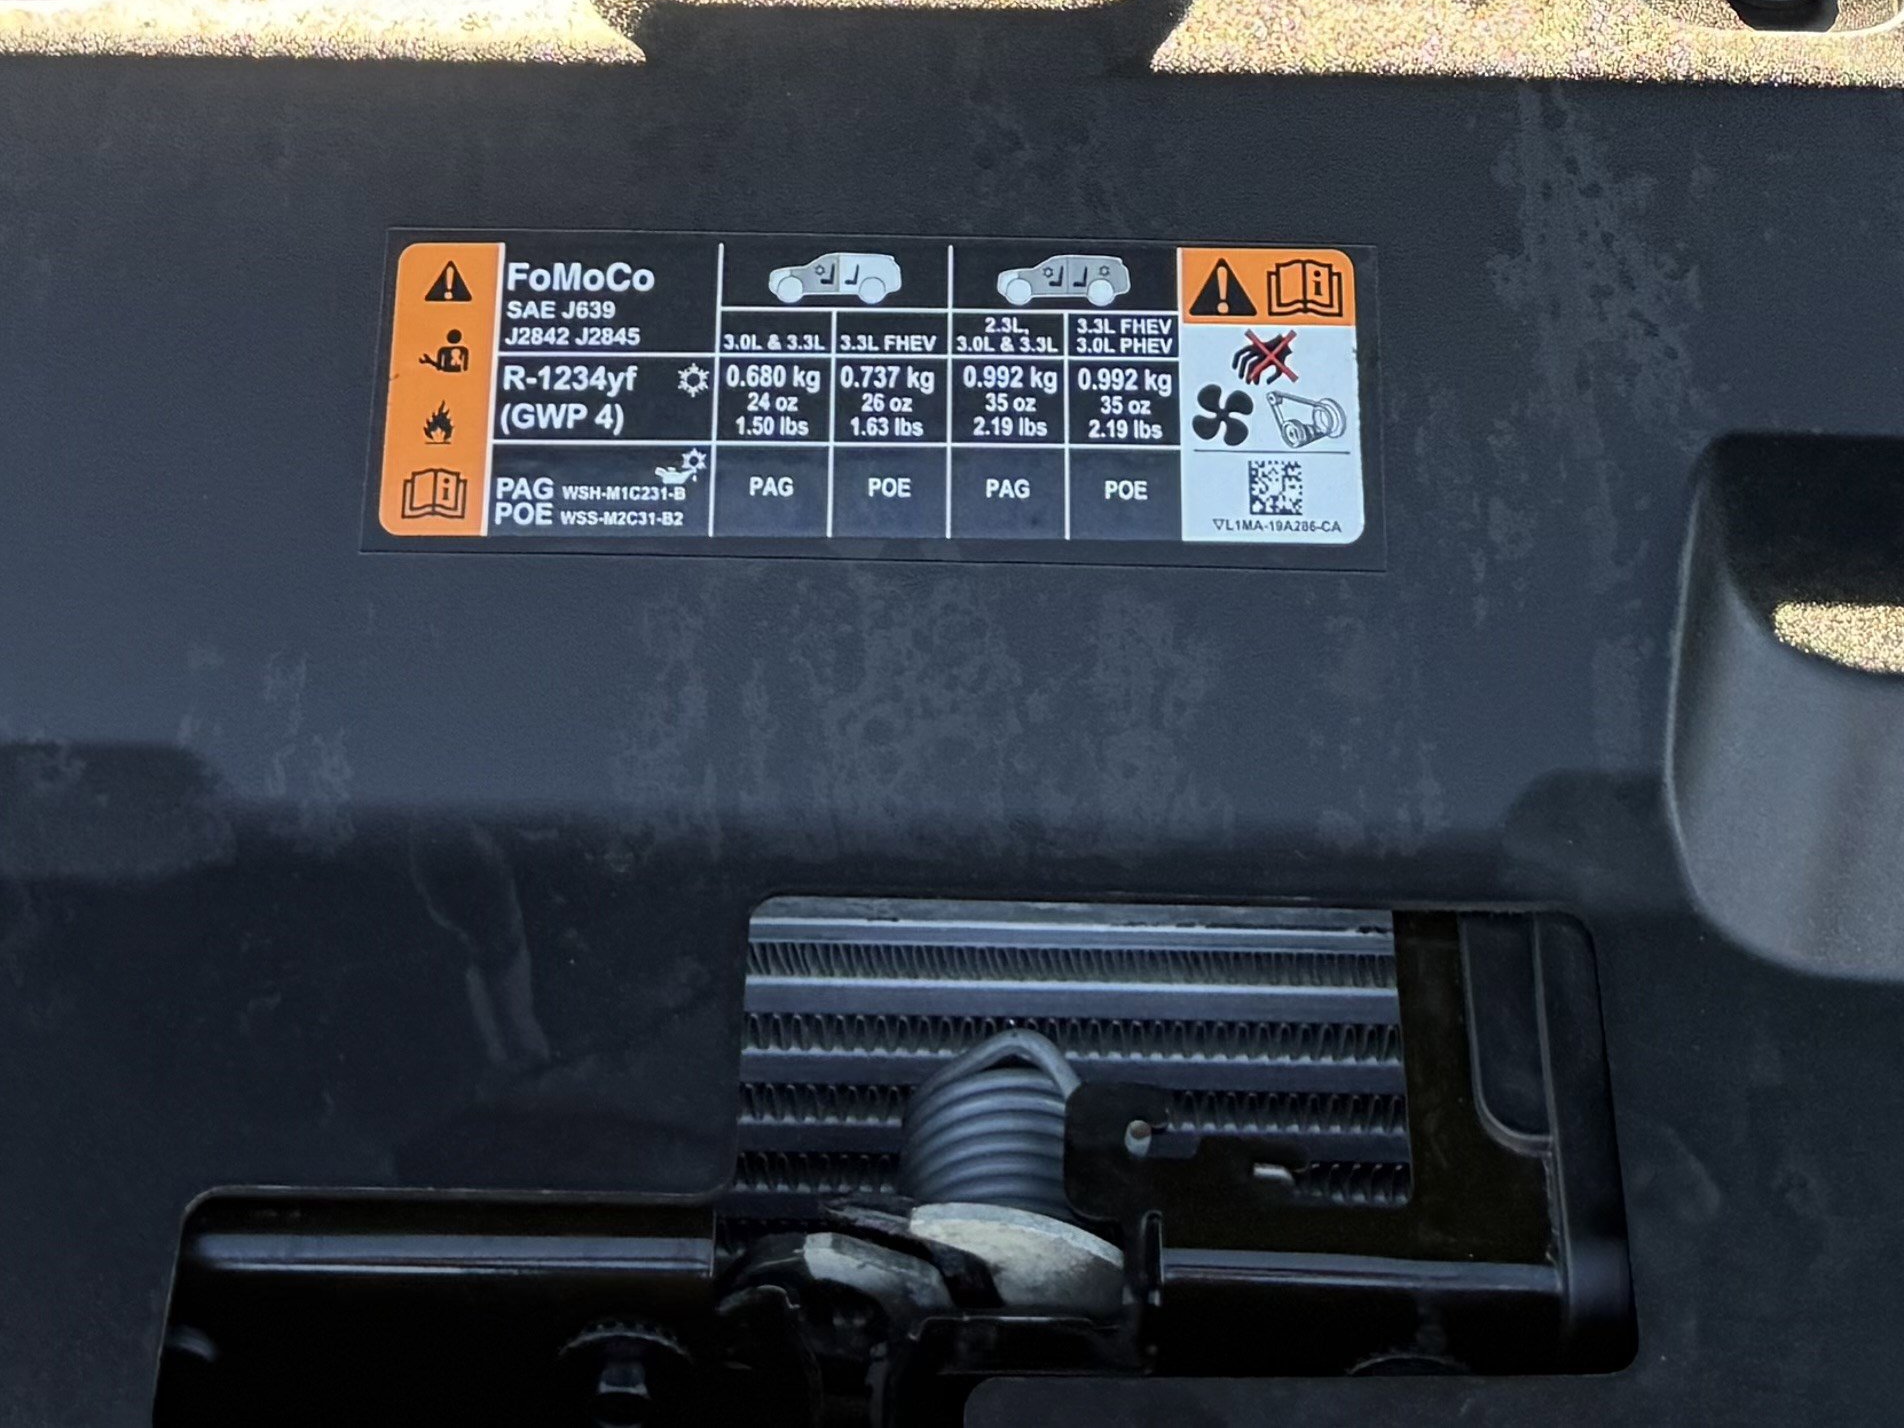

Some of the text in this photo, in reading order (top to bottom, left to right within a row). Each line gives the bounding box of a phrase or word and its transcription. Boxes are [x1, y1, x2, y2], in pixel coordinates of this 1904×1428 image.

[506, 261, 655, 292] FoMoCo
[506, 300, 616, 319] SAE J639
[504, 326, 641, 346] J2842 J2845
[984, 317, 1029, 335] 2.3L,
[1076, 318, 1172, 335] 3.3L FHEV
[723, 333, 826, 351] 3.0L & 3.3L
[840, 334, 937, 352] 3.3L FHEV
[956, 335, 1059, 353] 3.0L & 3.3L
[1076, 337, 1173, 355] 3.0L PHEV
[502, 365, 638, 397] R-1234yf
[725, 364, 821, 394] 0.680 kg
[840, 365, 935, 395] 0.737 kg
[963, 365, 1058, 395] 0.992 kg
[1077, 368, 1172, 397] 0.992 kg
[747, 393, 799, 412] 24 oz
[861, 393, 913, 413] 26 oz
[985, 393, 1037, 413] 35 oz
[1100, 395, 1152, 415] 35 oz
[501, 403, 625, 436] (GWP 4)
[735, 416, 810, 436] 1.50 lbs
[850, 417, 925, 437] 1.63 lbs
[973, 416, 1048, 437] 2.19 lbs
[1088, 419, 1164, 440] 2.19 lbs
[496, 477, 686, 501] PAG WSH-M1C231-B
[749, 476, 795, 497] PAG
[868, 477, 912, 498] POE
[985, 479, 1031, 499] PAG
[1104, 480, 1149, 500] POE
[495, 502, 684, 526] POE WSS-M2C31-B2
